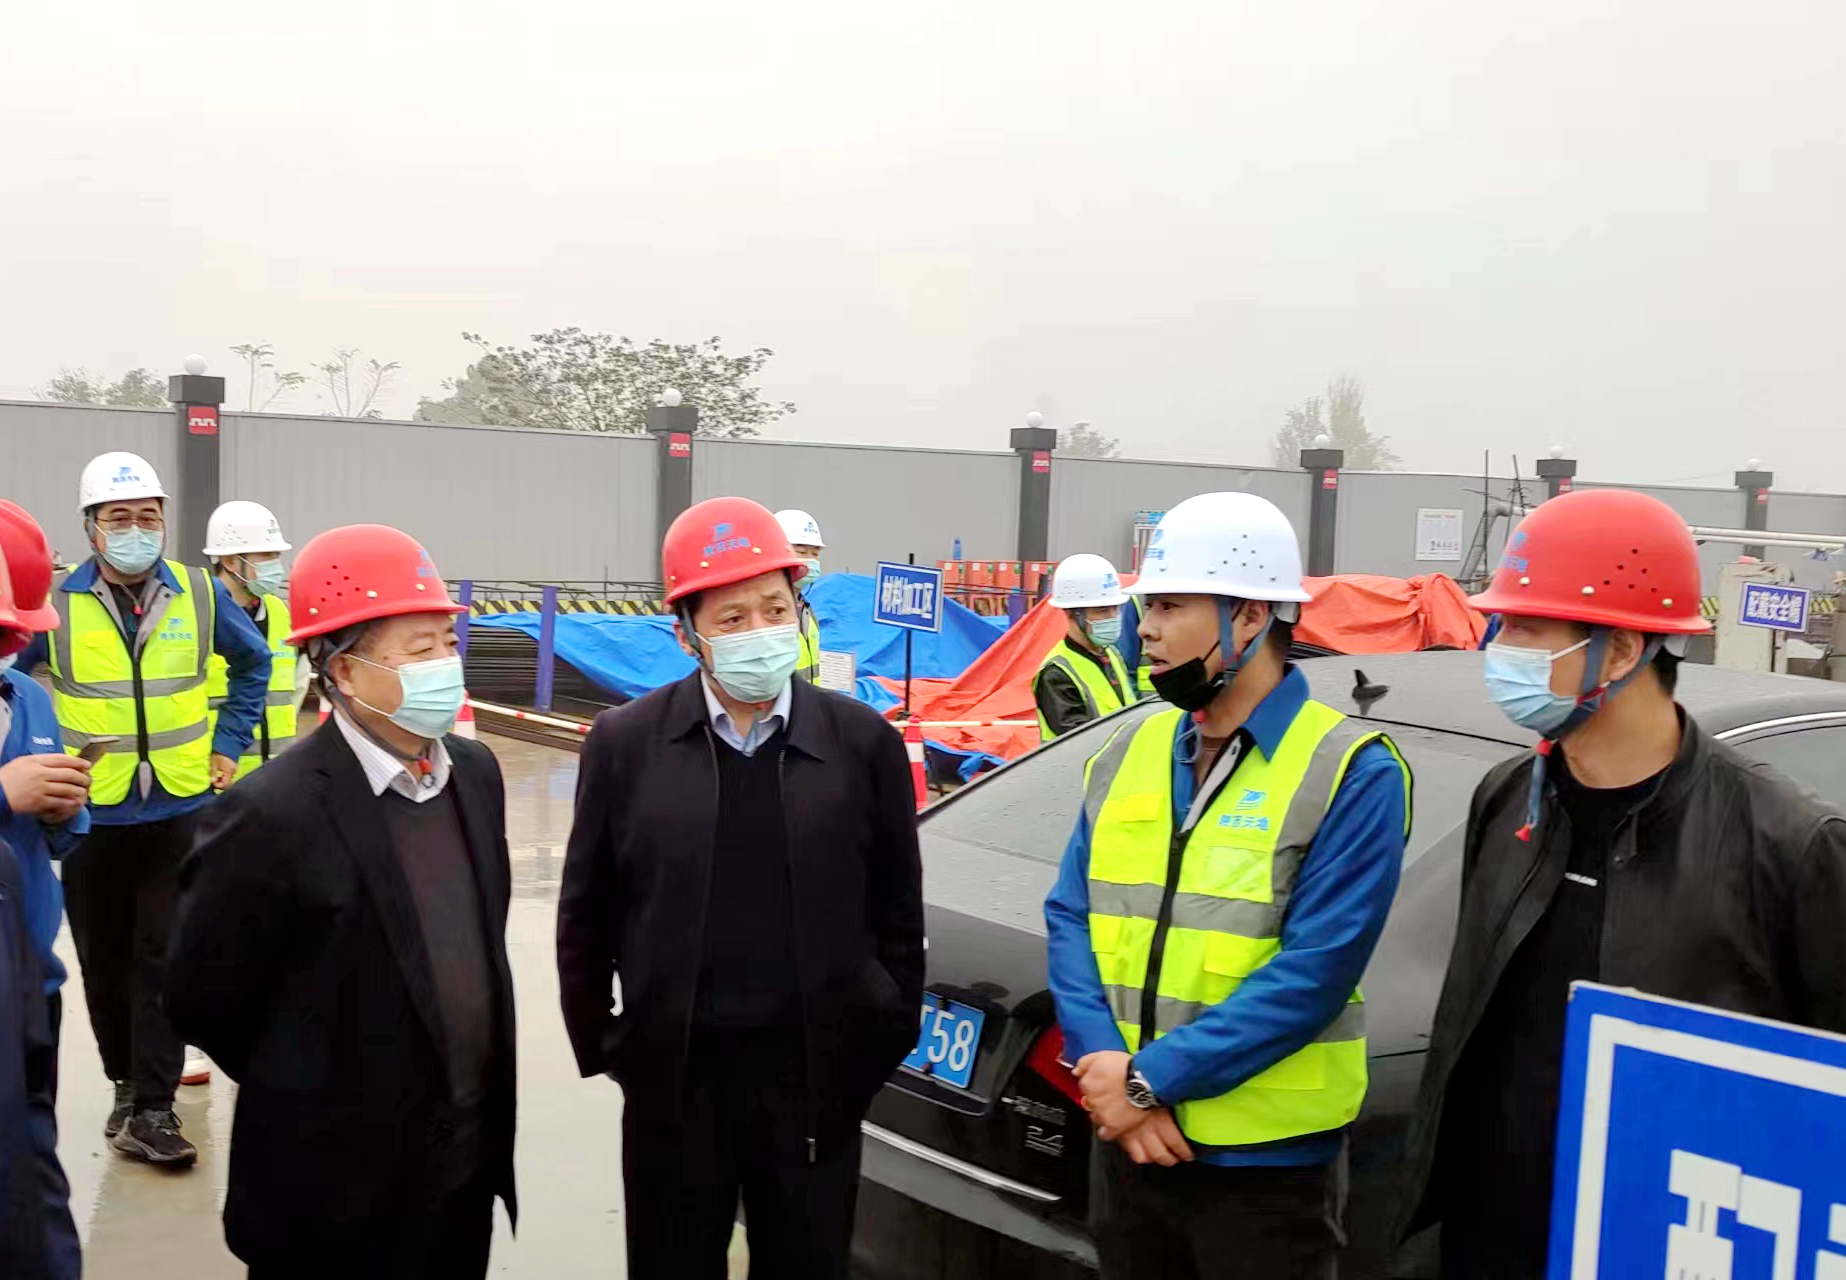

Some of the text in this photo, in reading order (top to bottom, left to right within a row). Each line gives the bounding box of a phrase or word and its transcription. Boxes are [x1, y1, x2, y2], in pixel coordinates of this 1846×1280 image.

[881, 575, 934, 619] 材料加工区
